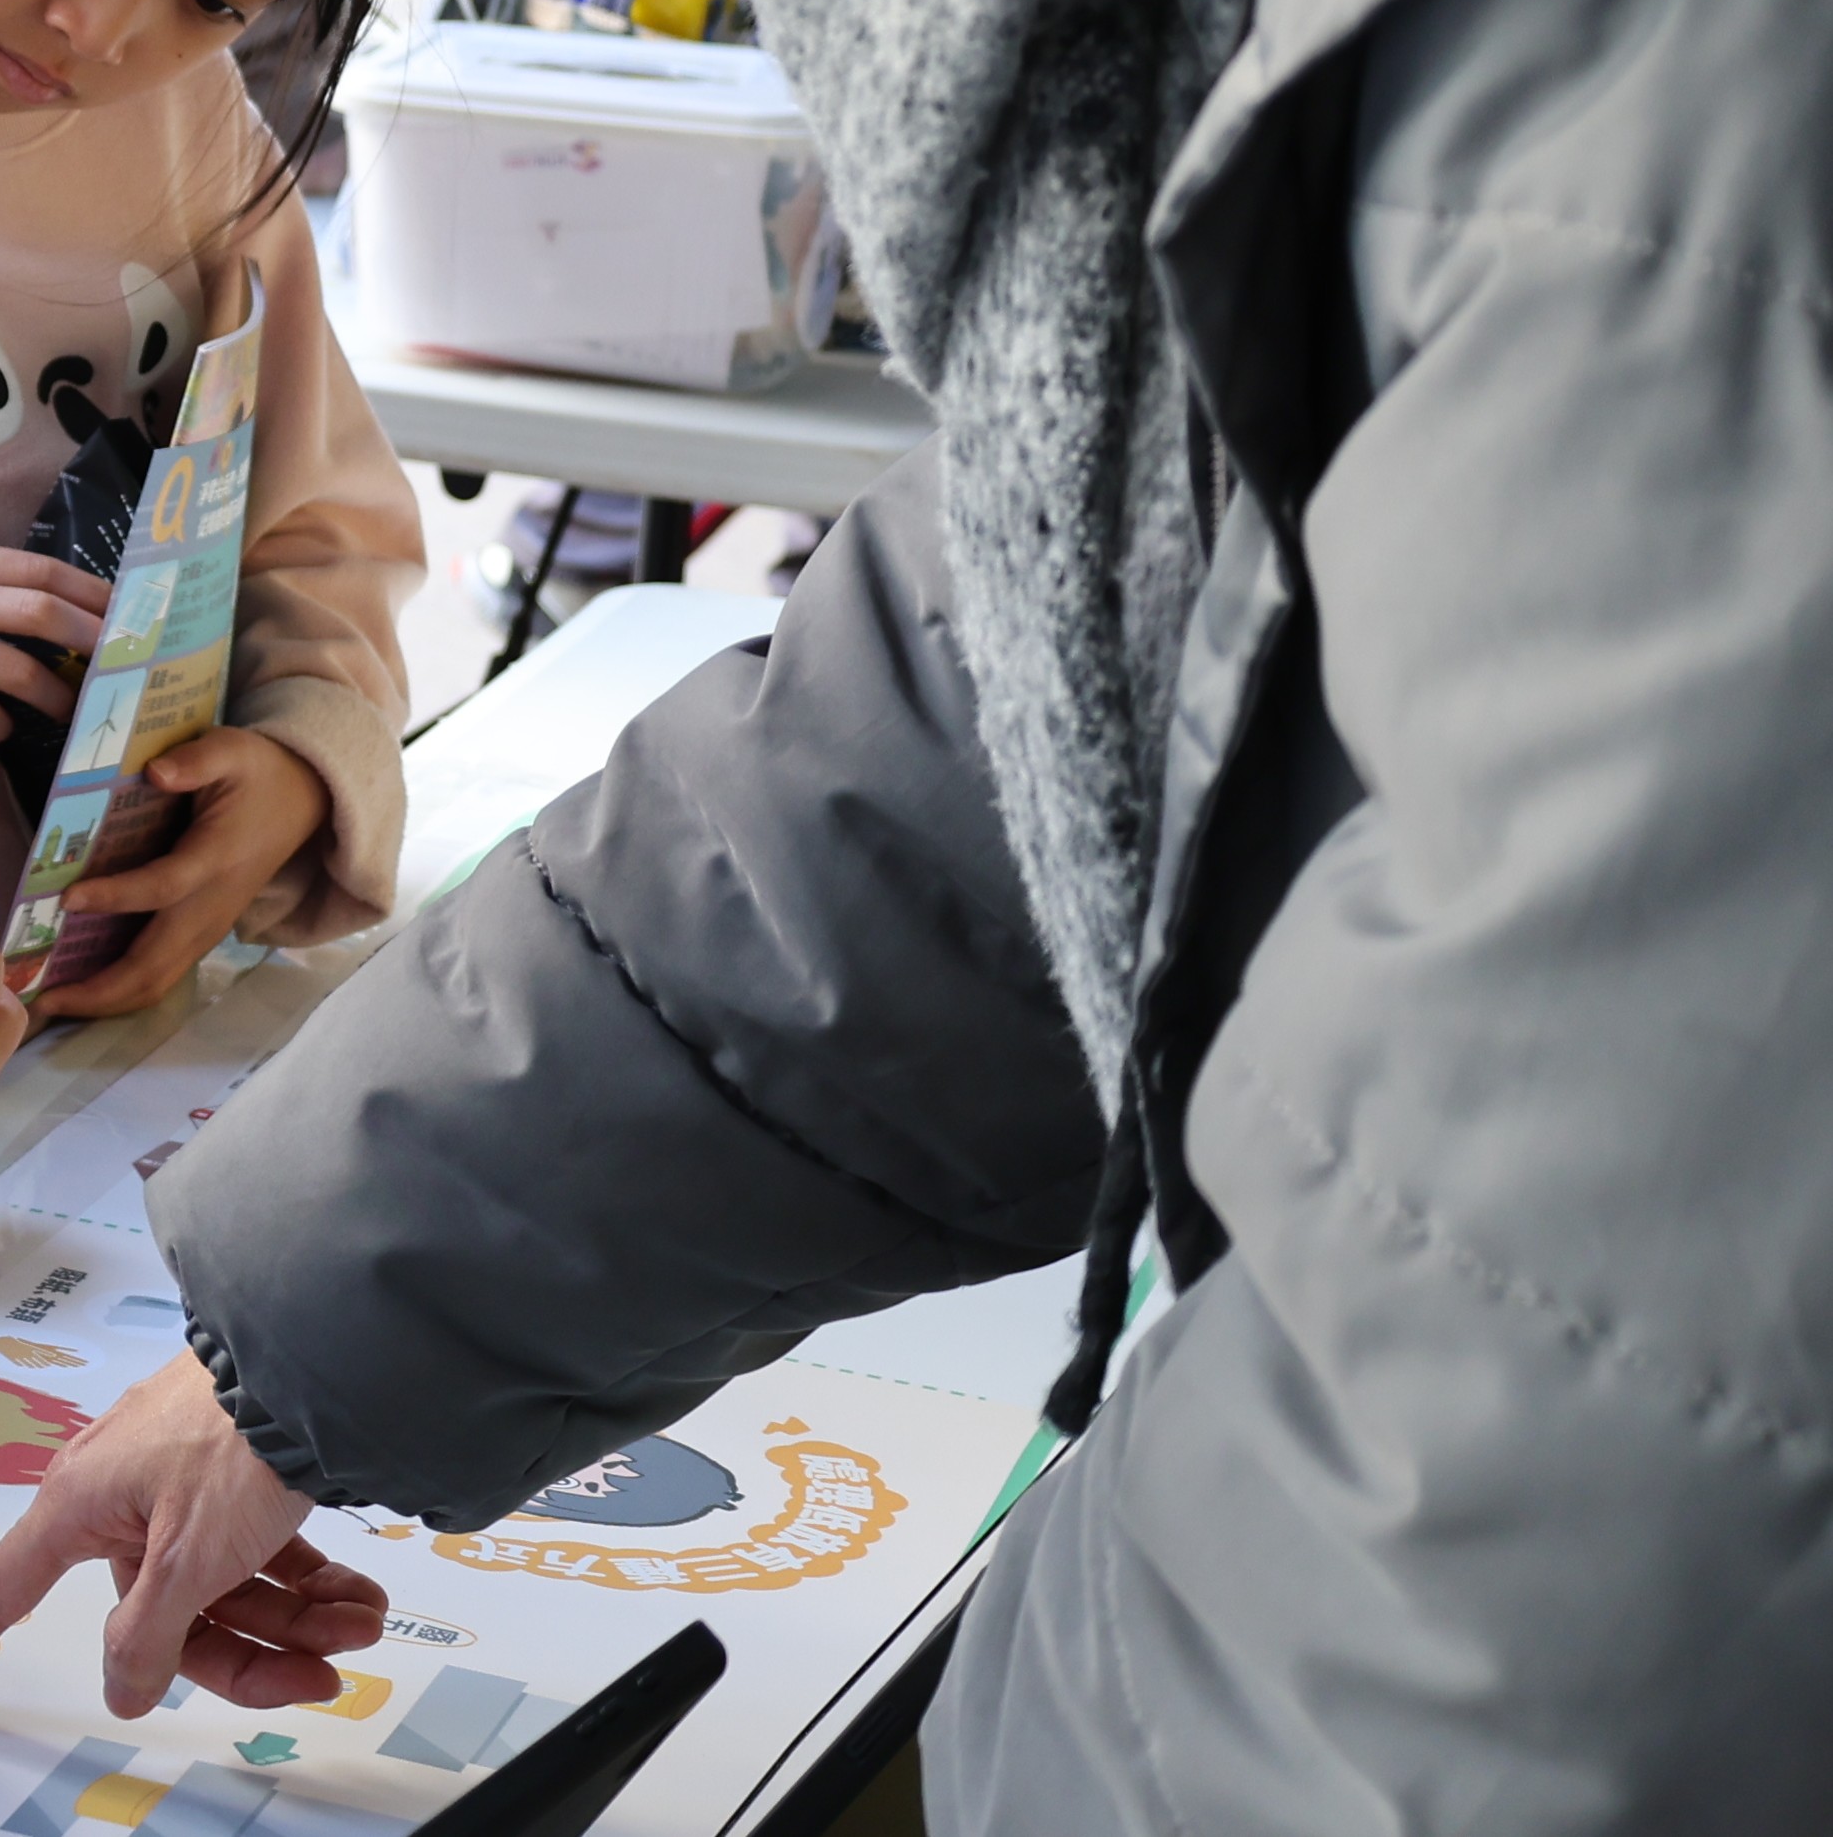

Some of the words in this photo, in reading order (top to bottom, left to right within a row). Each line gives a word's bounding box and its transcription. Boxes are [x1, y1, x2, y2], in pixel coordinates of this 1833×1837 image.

[459, 1452, 876, 1586] 處理低放有三種方式
